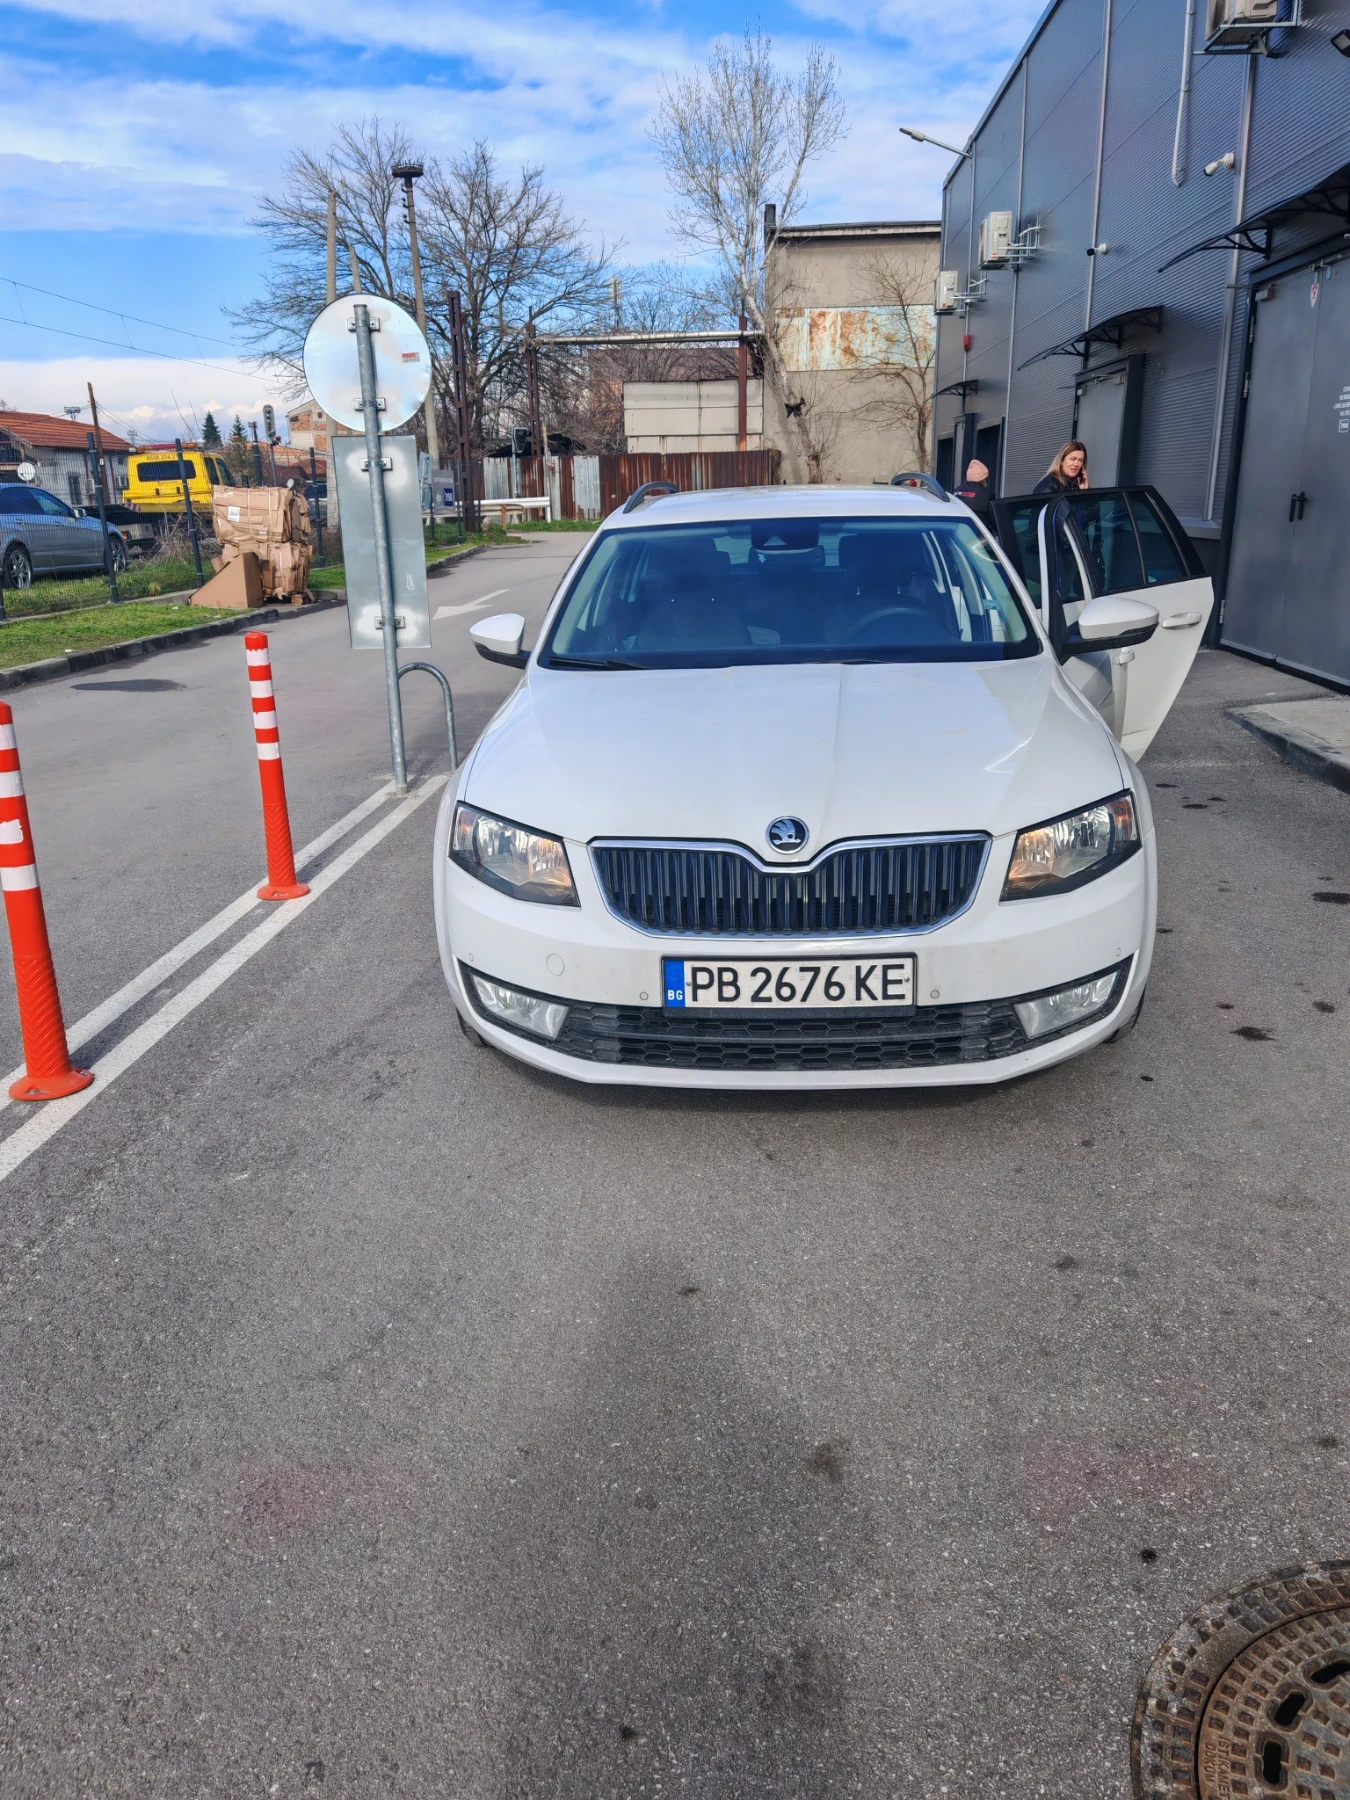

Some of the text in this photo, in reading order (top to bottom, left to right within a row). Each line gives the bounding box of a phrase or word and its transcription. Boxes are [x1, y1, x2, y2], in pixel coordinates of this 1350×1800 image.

[667, 990, 683, 1001] BG
[691, 963, 906, 1003] PB 2676 KE
